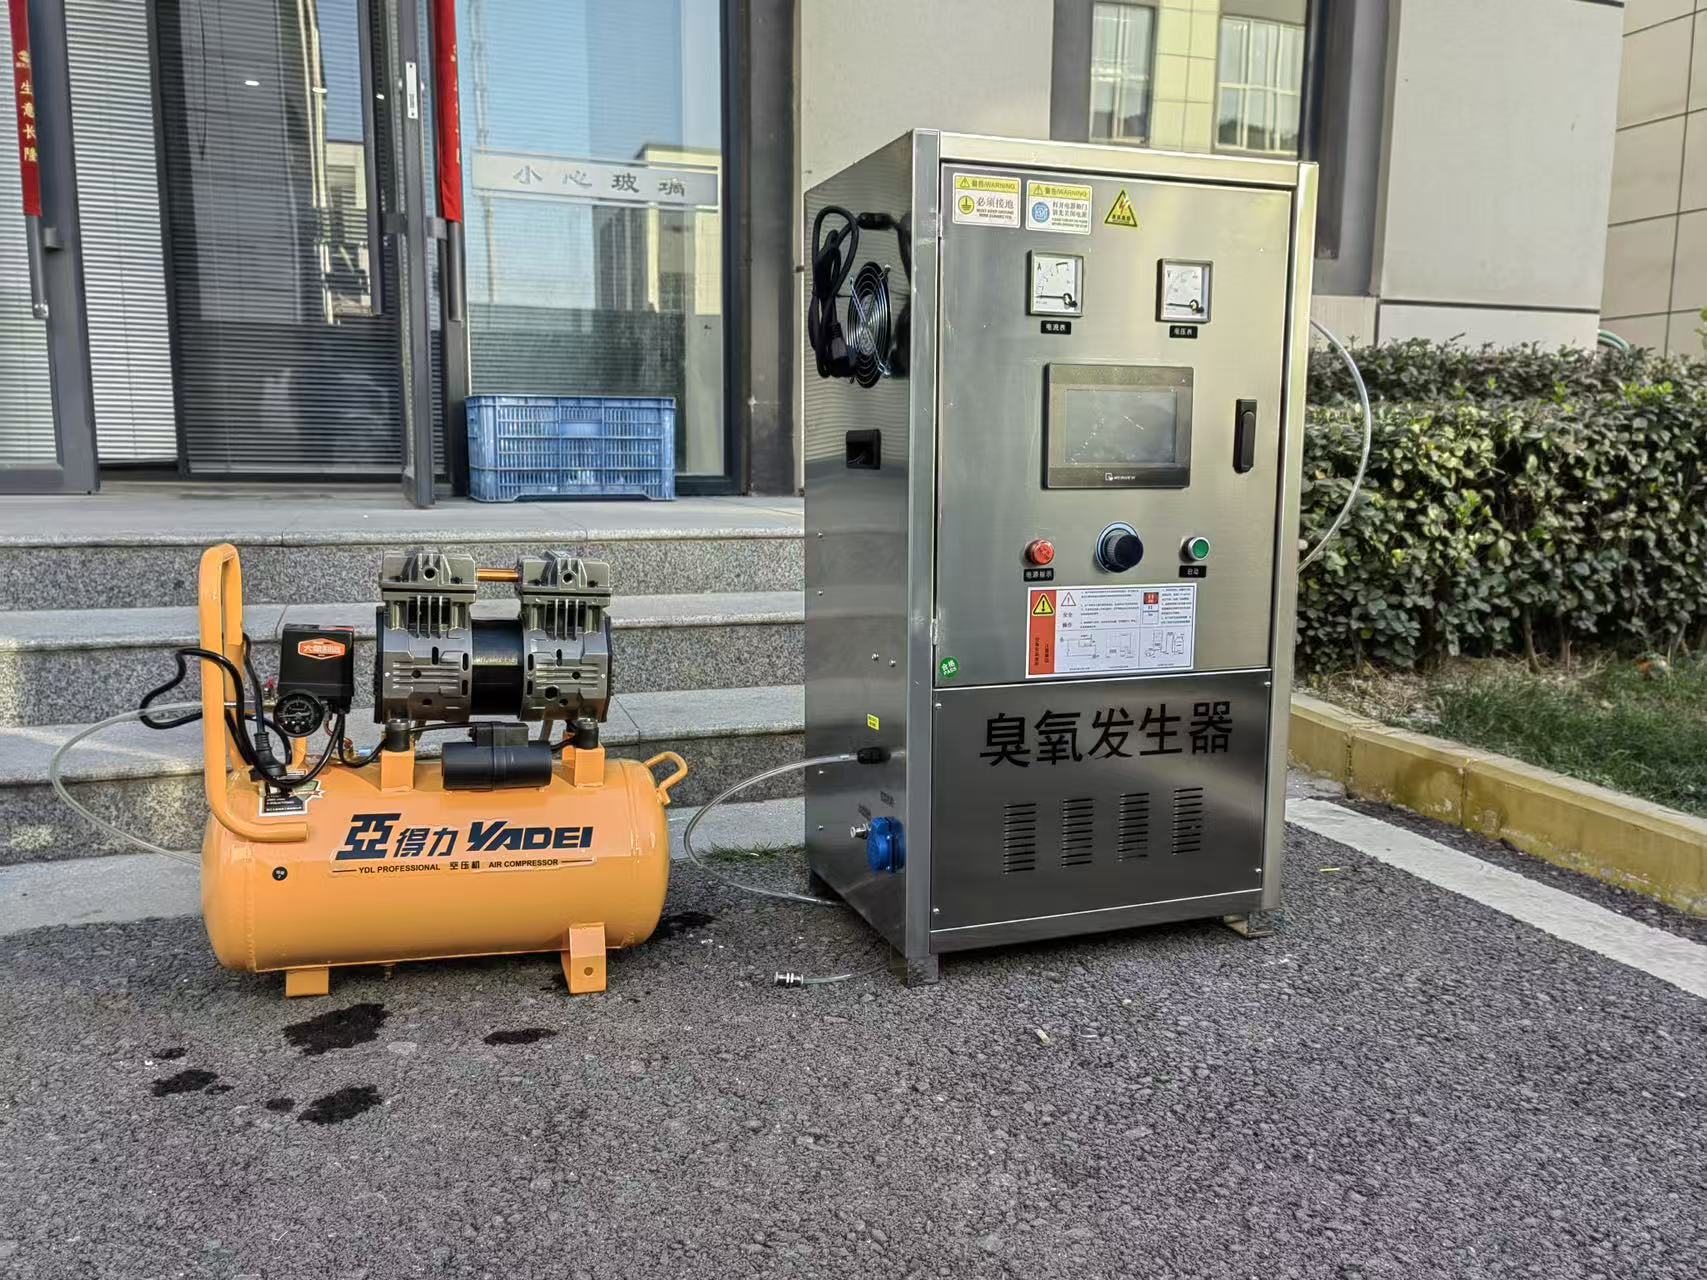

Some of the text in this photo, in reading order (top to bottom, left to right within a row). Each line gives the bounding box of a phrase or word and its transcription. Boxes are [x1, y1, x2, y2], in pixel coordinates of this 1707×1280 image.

[512, 164, 686, 198] 小心玻璃
[976, 196, 1015, 209] 必须接地
[980, 701, 1233, 768] 臭氧发生器
[466, 820, 594, 851] YADEI
[358, 866, 376, 874] YDL
[377, 863, 441, 873] PROFESSIONAL
[449, 860, 480, 870] 空压机
[504, 858, 559, 868] COMPRESSOR
